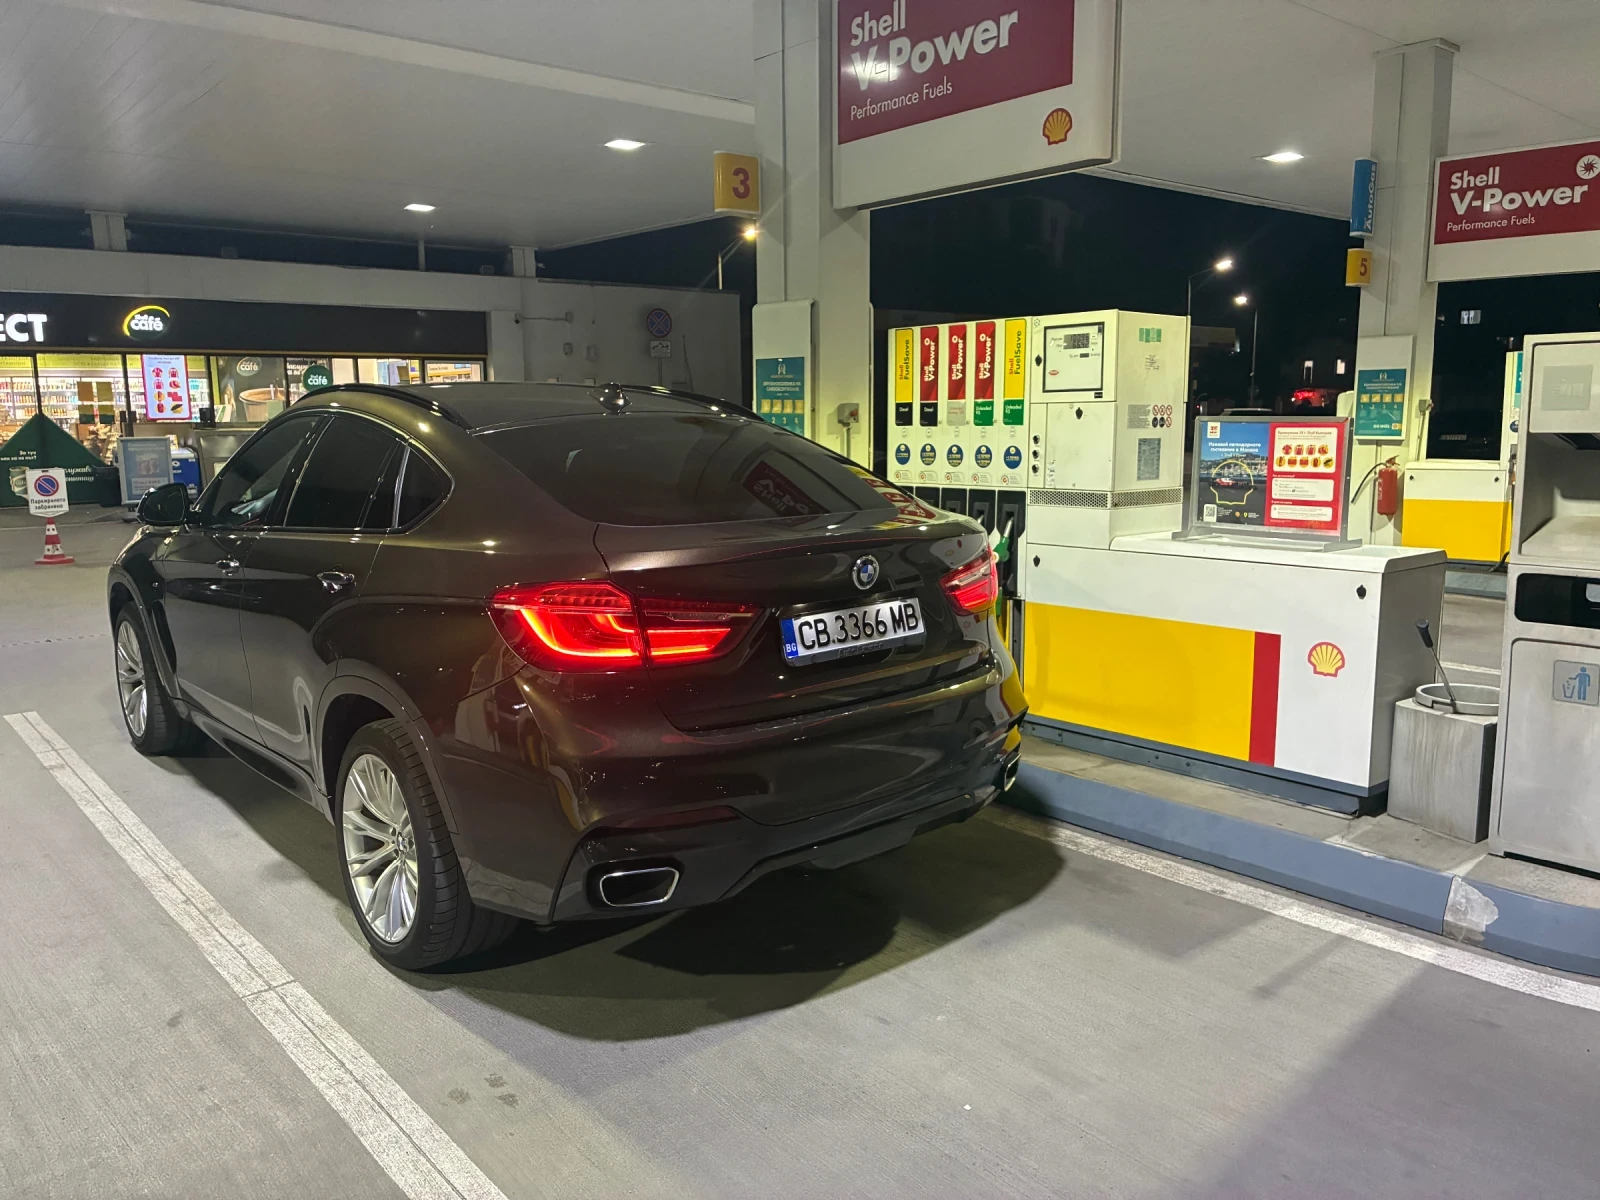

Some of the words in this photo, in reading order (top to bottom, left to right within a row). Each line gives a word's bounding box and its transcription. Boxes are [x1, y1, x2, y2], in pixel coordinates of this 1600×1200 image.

[850, 0, 906, 47] Shell
[850, 10, 1019, 91] V-Power
[850, 91, 919, 121] Performance
[923, 76, 953, 100] Fuels
[732, 167, 751, 200] 3
[1450, 167, 1501, 190] Shell
[1364, 163, 1377, 230] AutoGas
[1450, 182, 1589, 216] V-Power
[1446, 217, 1508, 233] Performance
[1510, 213, 1536, 228] Fuels
[1359, 258, 1368, 277] 5
[130, 316, 164, 331] café
[928, 341, 936, 381] V-Power
[956, 339, 964, 380] V-Power
[983, 337, 992, 379] V-Power
[1014, 330, 1022, 375] FuelSave
[308, 376, 328, 386] café
[771, 416, 776, 424] 2
[782, 416, 787, 424] 3
[889, 602, 919, 634] MB
[785, 642, 798, 653] BG
